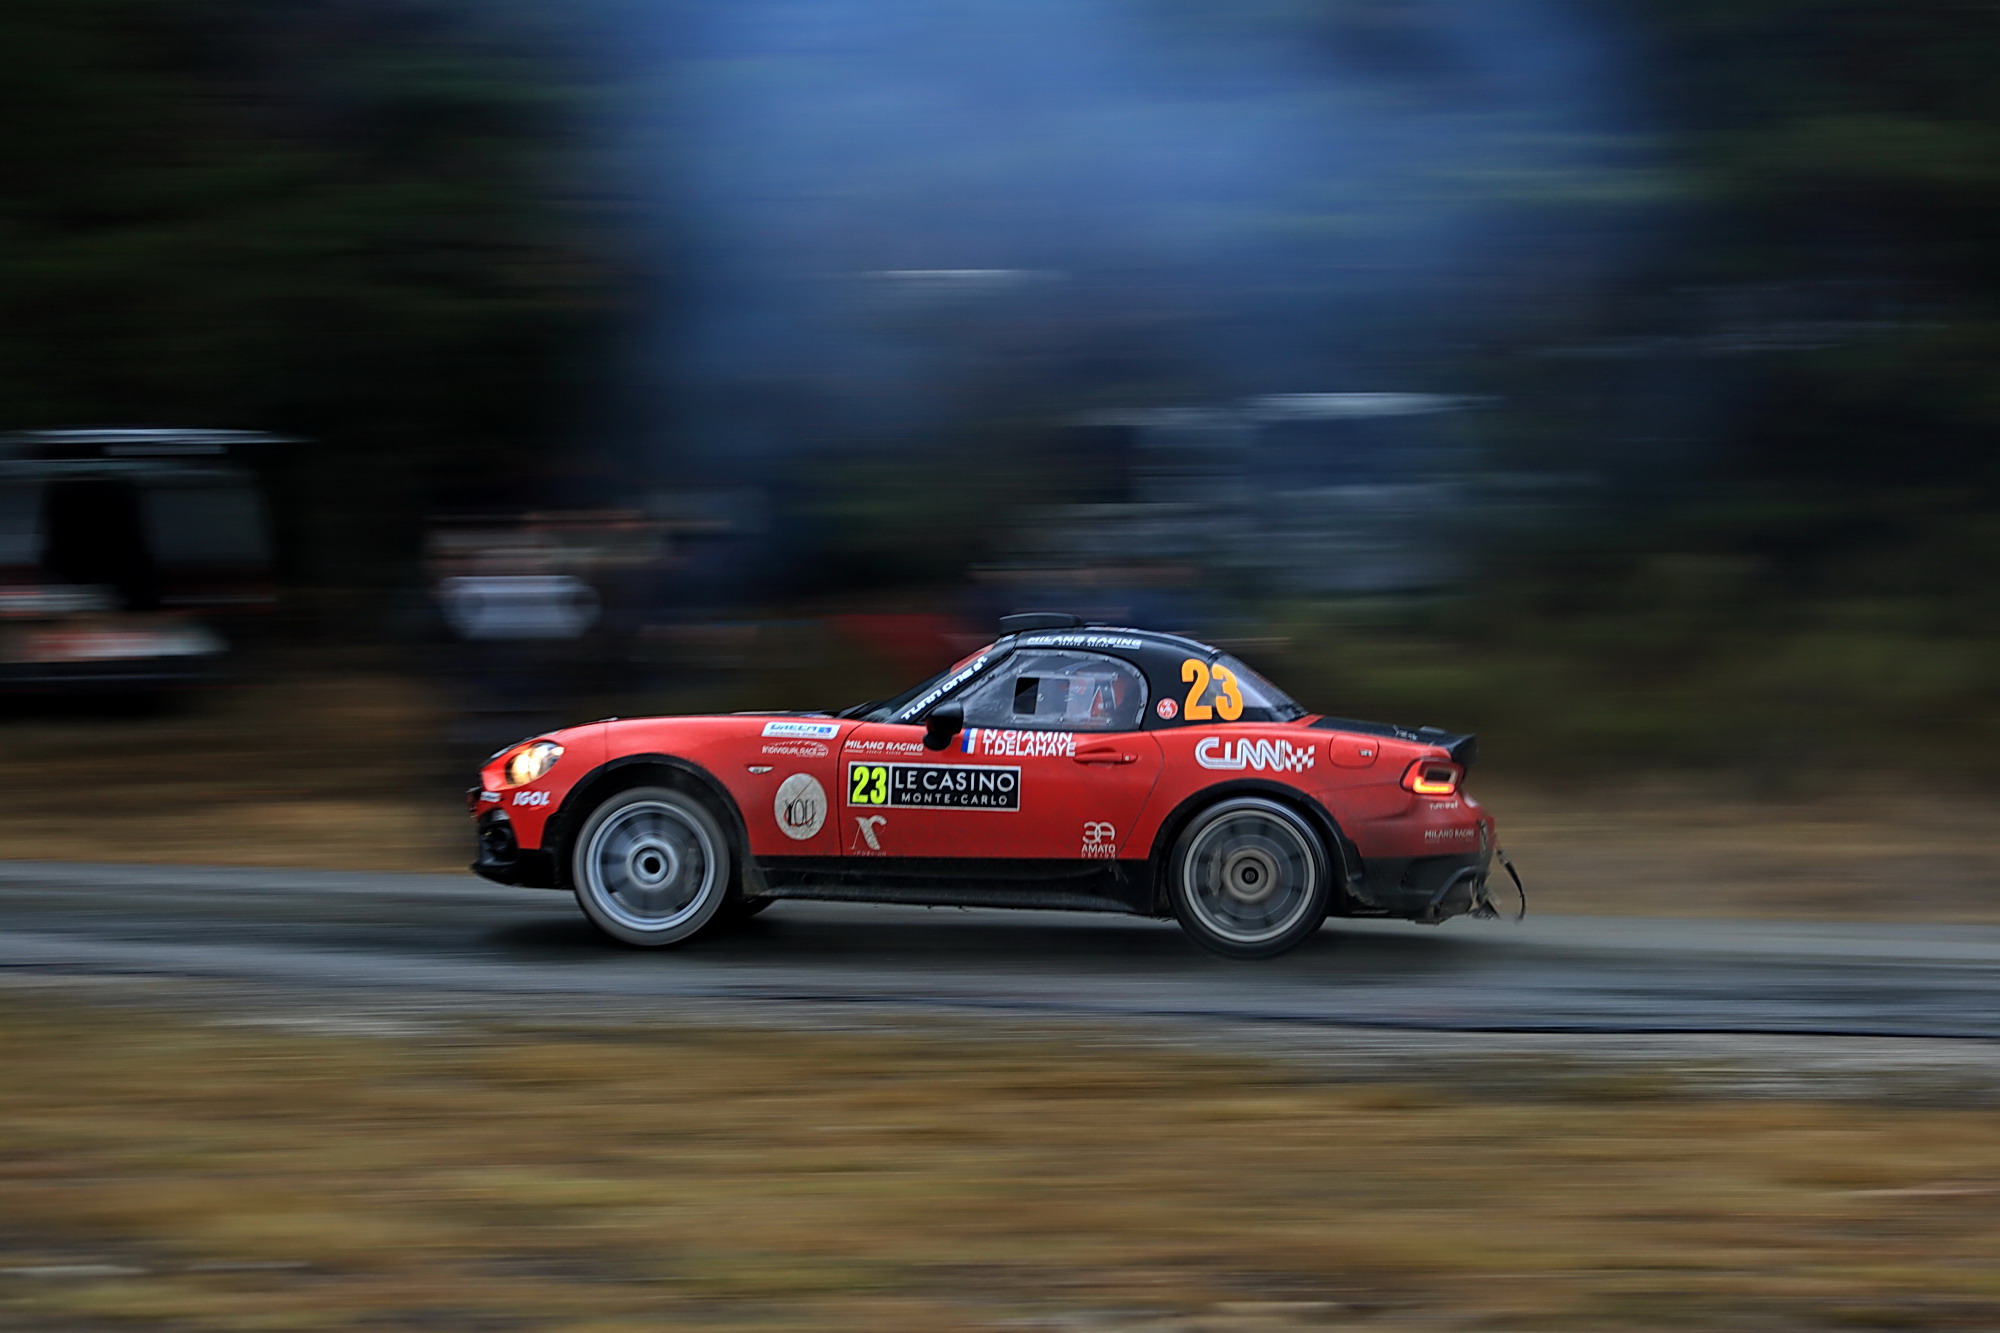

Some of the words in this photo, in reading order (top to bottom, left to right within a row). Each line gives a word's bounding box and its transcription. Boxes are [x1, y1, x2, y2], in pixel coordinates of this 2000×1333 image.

[1027, 635, 1085, 645] MILANO
[1086, 636, 1142, 648] RACING
[1181, 658, 1244, 721] 23
[844, 739, 885, 749] MILANO
[885, 741, 924, 752] RACING
[983, 738, 1077, 757] T.DELAHAYE
[851, 765, 888, 805] 23
[894, 769, 918, 790] LE
[922, 770, 1015, 793] CASINO
[512, 790, 551, 805] IGOL
[1081, 843, 1116, 854] AMATO
